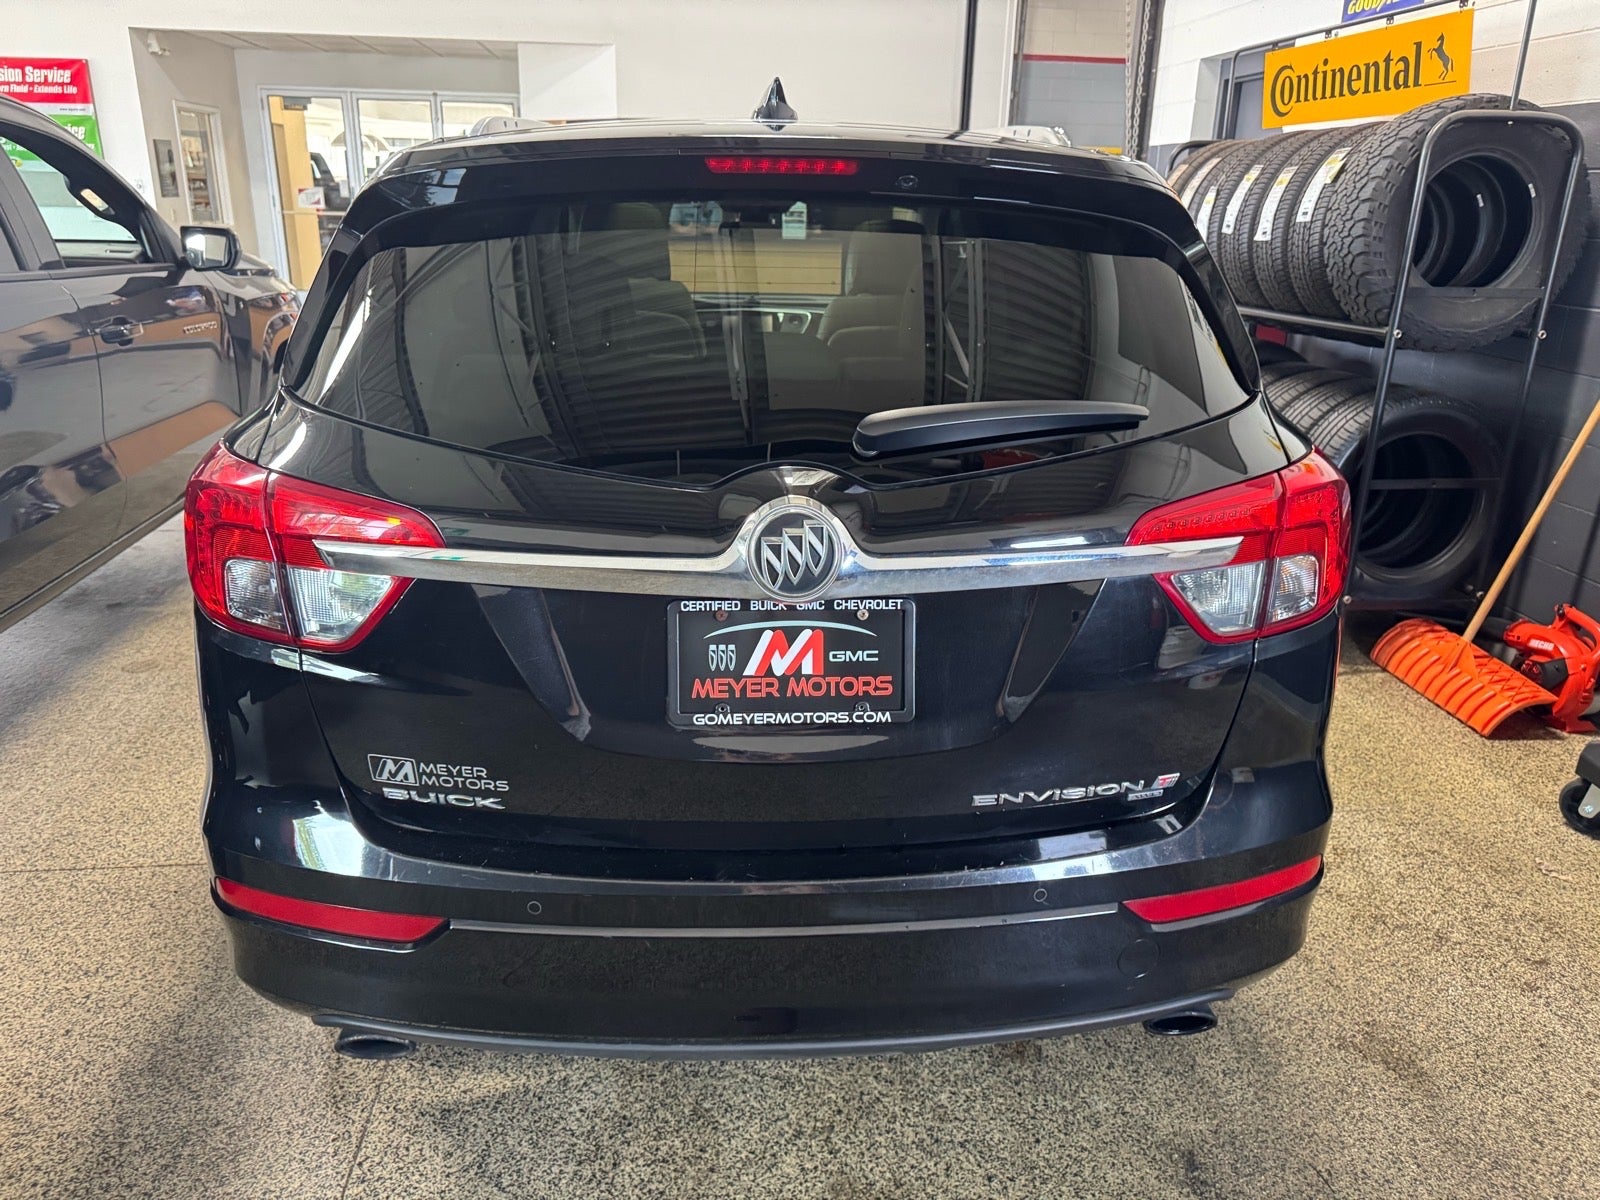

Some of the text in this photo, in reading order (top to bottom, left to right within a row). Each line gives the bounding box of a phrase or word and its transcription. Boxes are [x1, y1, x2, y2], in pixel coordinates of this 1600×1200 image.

[25, 66, 71, 83] Service
[1270, 40, 1422, 117] Continental
[10, 84, 28, 93] Fluid
[34, 85, 62, 94] Extends
[64, 85, 77, 94] Life
[680, 599, 903, 611] CERTIFIED BUICK GMC CHEVROLET
[828, 650, 879, 662] GMC
[691, 675, 893, 699] MEYER MOTORS
[692, 711, 892, 726] GOMEYERMOTORS.COM
[419, 762, 487, 778] MEYER
[421, 774, 509, 792] MOTORS
[382, 787, 506, 809] BUICK
[971, 779, 1144, 807] ENVISION
